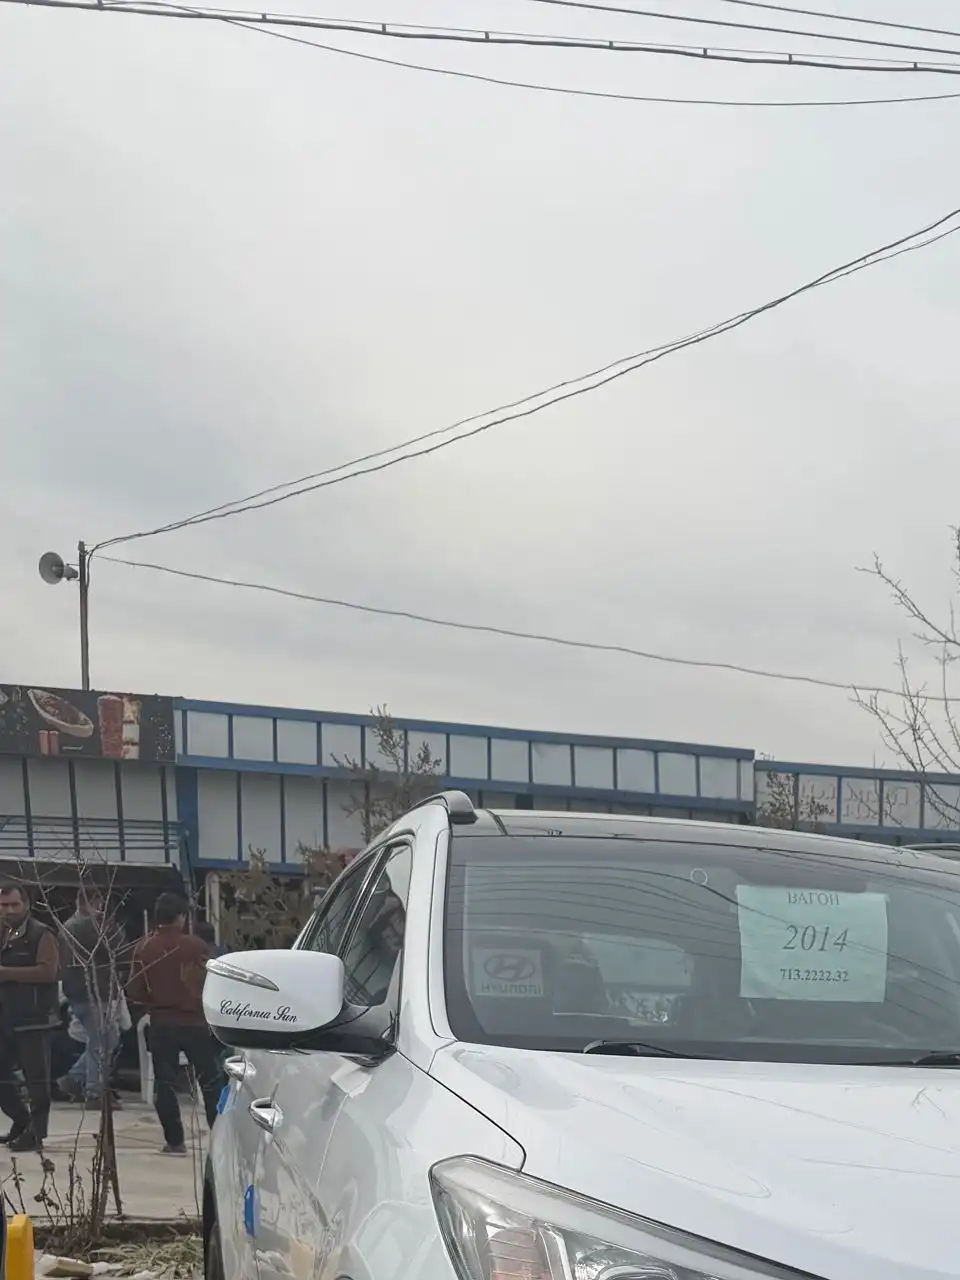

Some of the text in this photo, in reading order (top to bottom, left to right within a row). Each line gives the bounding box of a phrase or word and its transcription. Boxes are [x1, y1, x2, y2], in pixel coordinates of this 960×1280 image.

[782, 924, 849, 952] 2014
[779, 968, 849, 982] 713.2222.32
[220, 999, 298, 1023] California Sun
